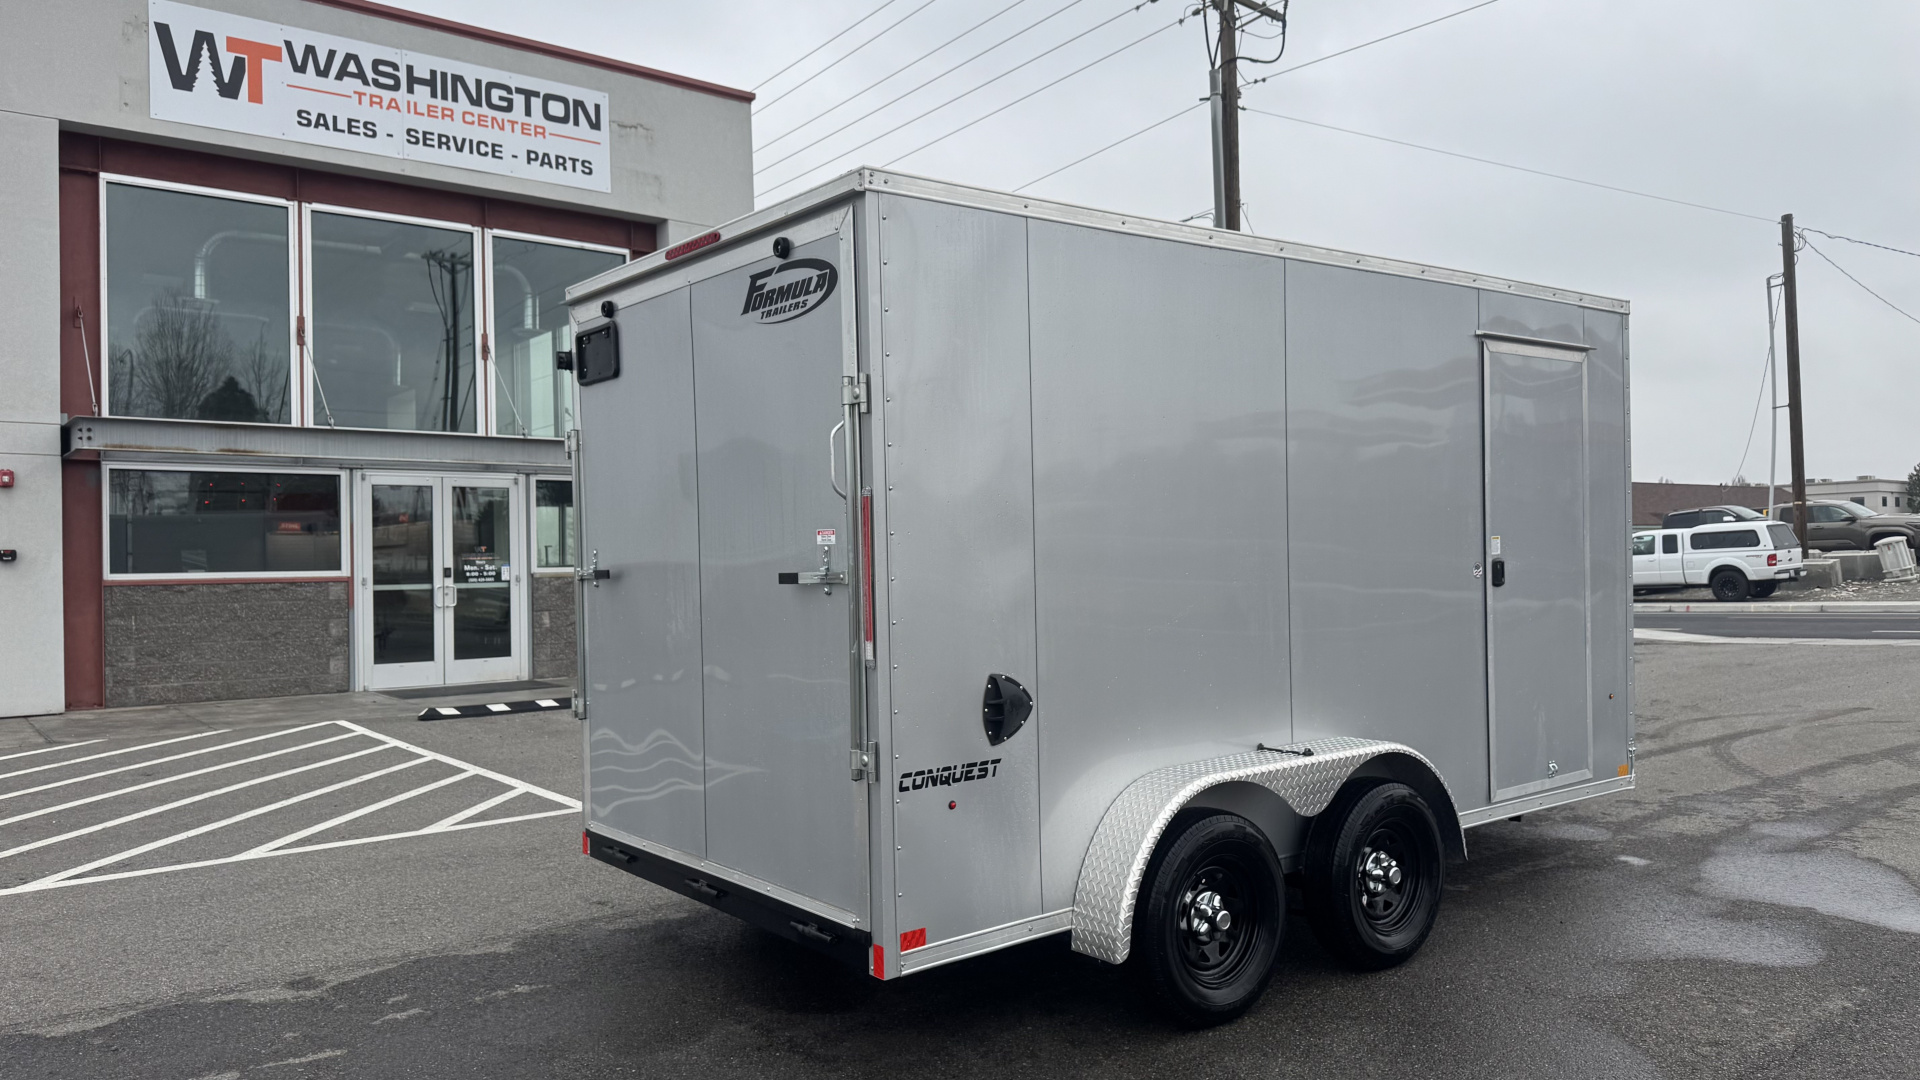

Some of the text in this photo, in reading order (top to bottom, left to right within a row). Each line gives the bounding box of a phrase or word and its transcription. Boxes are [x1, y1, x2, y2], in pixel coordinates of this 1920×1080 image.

[154, 21, 283, 105] WT
[284, 40, 602, 131] WASHINGTON
[297, 109, 378, 140] SALES
[406, 128, 504, 160] SERVICE
[526, 150, 595, 176] PARTS
[353, 91, 547, 139] TRAILER CENTER
[760, 298, 809, 320] TRAILERS
[898, 758, 1002, 793] CONQUEST
